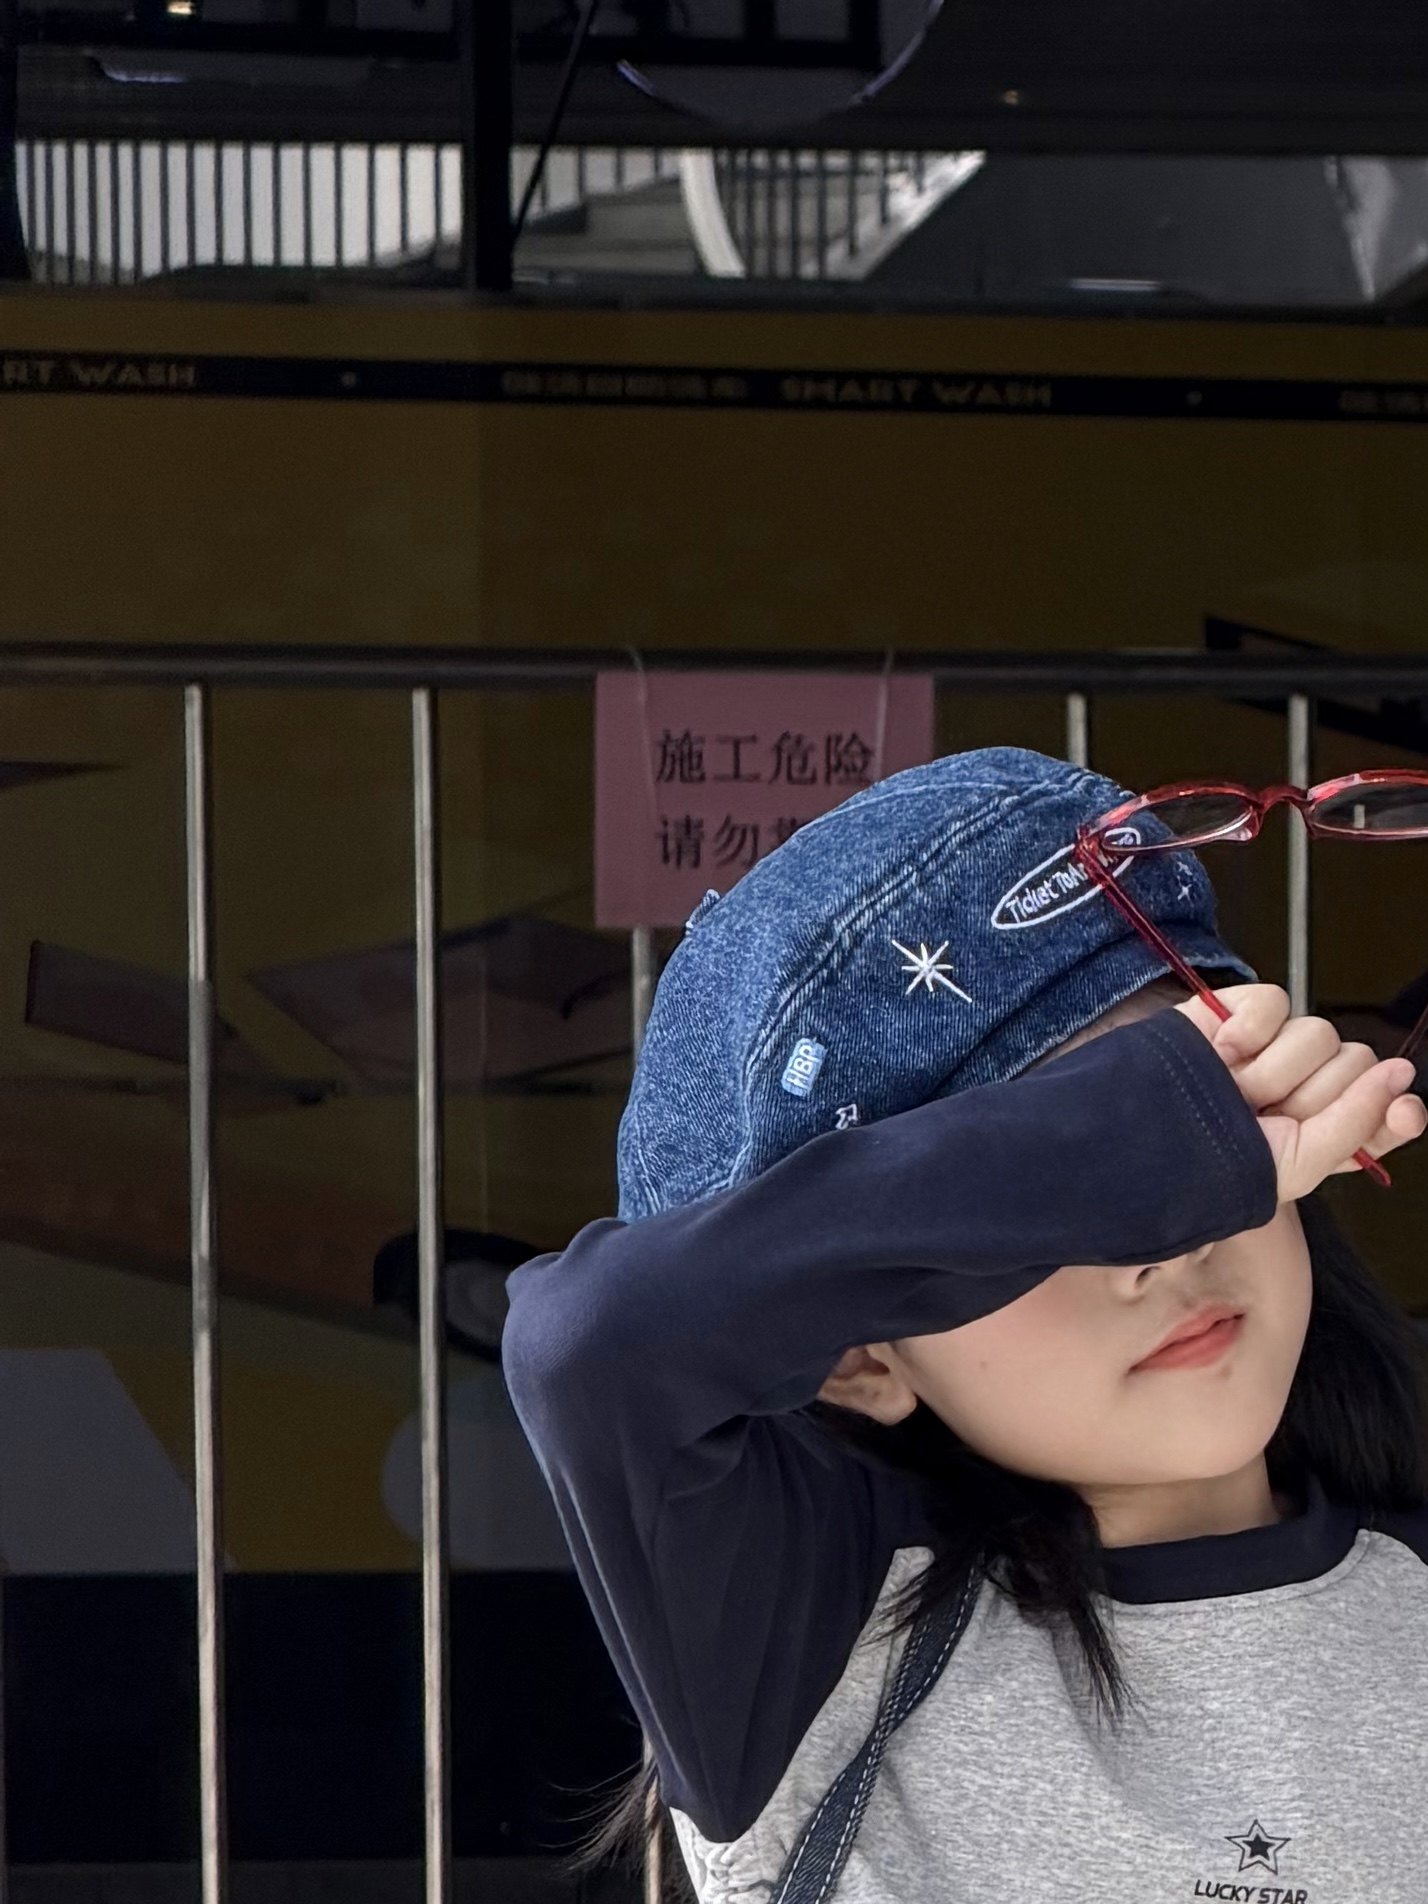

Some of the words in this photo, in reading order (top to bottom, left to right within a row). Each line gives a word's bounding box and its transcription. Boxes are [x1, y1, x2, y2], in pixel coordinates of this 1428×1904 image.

[68, 360, 197, 388] WASH
[779, 374, 917, 405] SMART
[927, 378, 1053, 409] WASH
[656, 730, 873, 784] 施工危险
[1194, 1879, 1255, 1903] LUCKY
